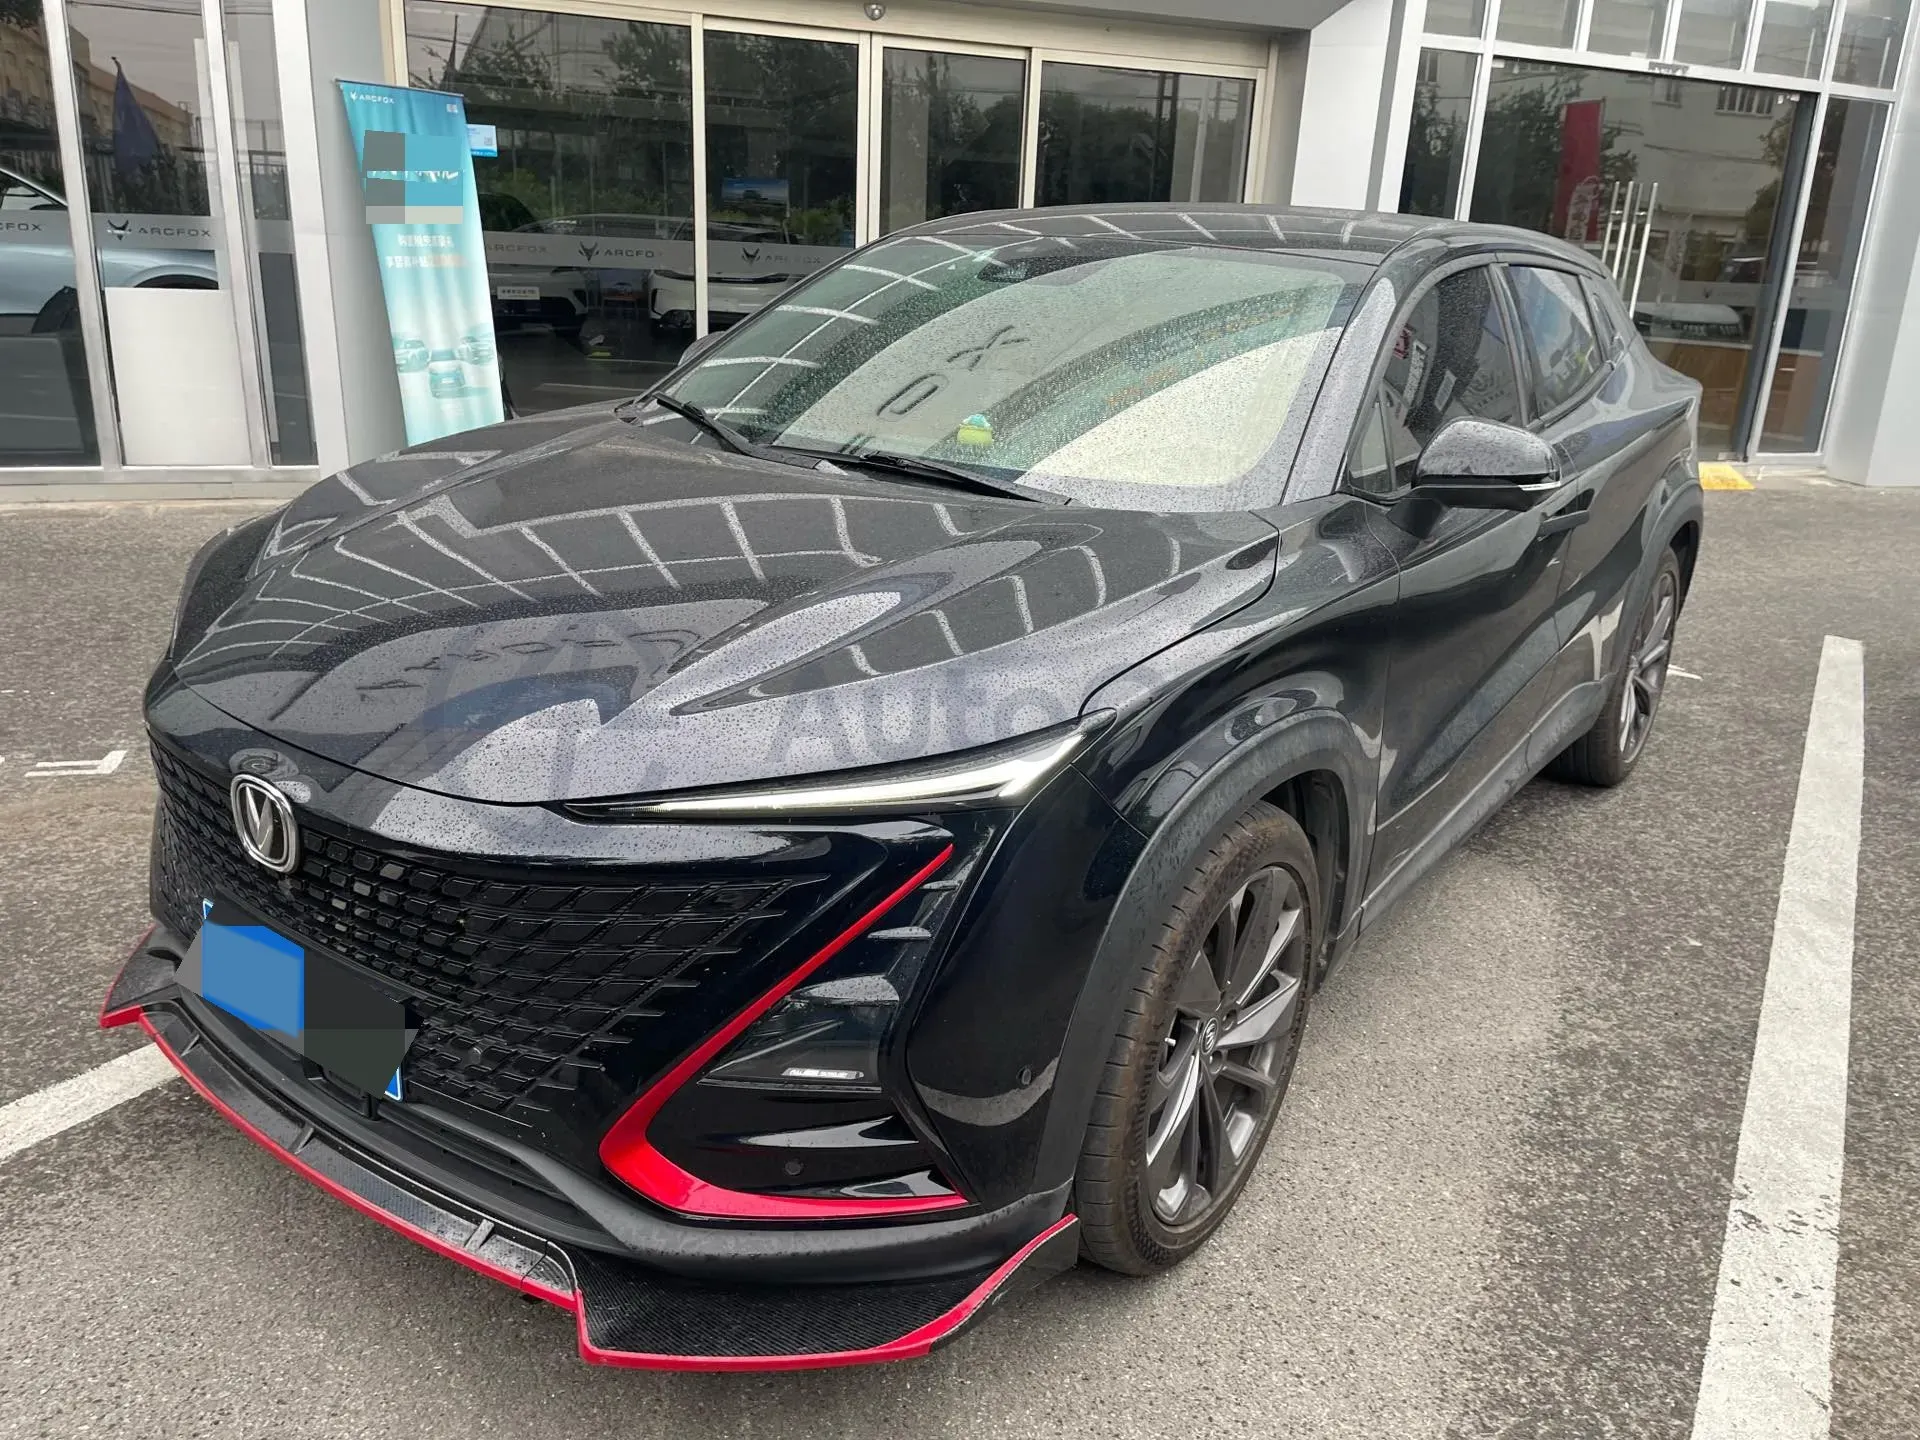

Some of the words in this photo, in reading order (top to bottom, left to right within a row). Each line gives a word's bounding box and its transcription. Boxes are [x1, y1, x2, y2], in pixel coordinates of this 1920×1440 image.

[359, 94, 395, 104] ARCFOX
[138, 227, 211, 237] ARCFOX
[765, 255, 821, 265] ARCOX
